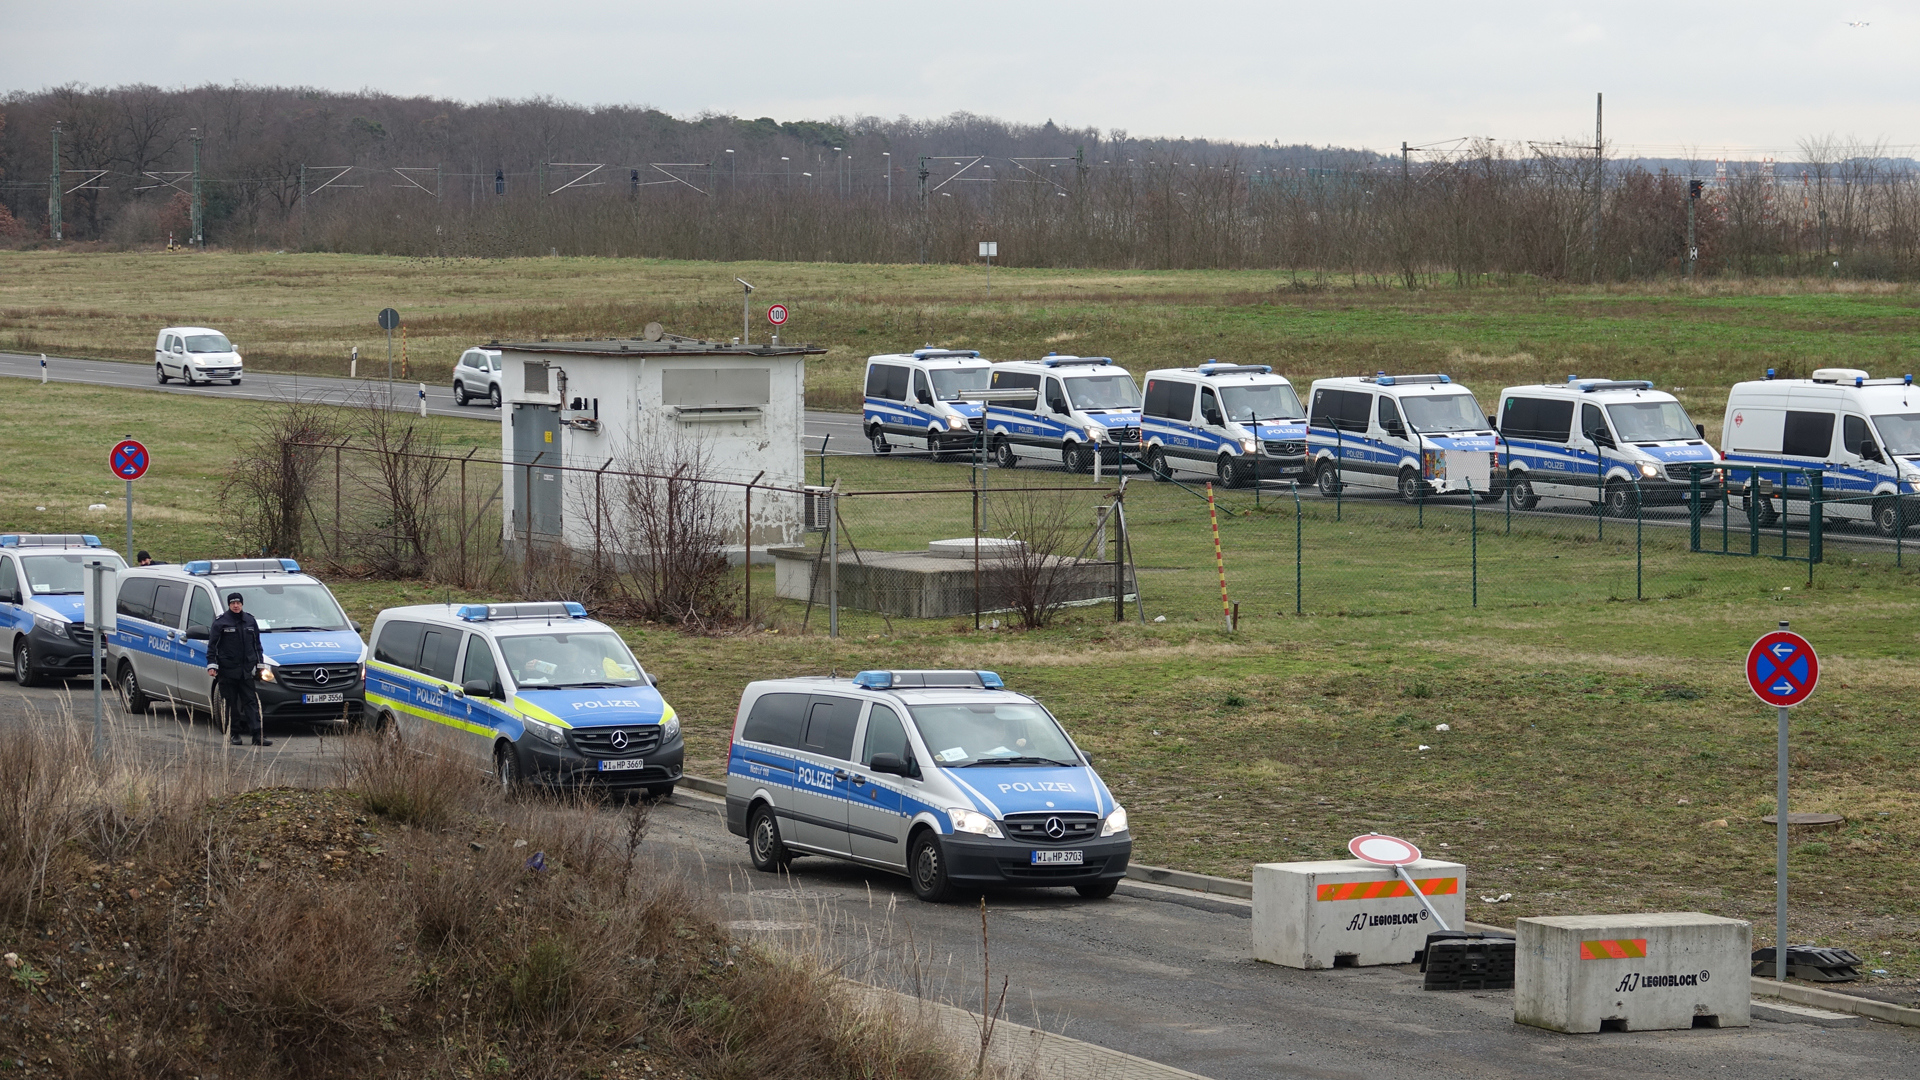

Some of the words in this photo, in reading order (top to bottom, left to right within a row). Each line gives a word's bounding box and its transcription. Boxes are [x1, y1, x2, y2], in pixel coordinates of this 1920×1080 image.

[772, 310, 784, 320] 100
[1018, 425, 1034, 434] POLIZEI
[1173, 436, 1189, 446] POLIZEI
[1452, 440, 1491, 448] POLIZEI
[1346, 450, 1365, 459] POLIZEI
[1665, 450, 1703, 458] POLIZEI
[1544, 460, 1565, 470] POLIZEI
[148, 635, 171, 653] POLIZEI
[278, 641, 341, 650] POLIZEI
[416, 686, 443, 708] POLIZEI
[571, 700, 641, 711] POLIZEI
[602, 761, 611, 770] WI
[616, 761, 626, 769] HP
[627, 760, 643, 769] 3669
[797, 766, 834, 791] POLIZEI
[997, 781, 1077, 794] POLIZEI
[1037, 852, 1047, 862] WI
[1052, 852, 1062, 861] HP
[1064, 851, 1082, 861] 3703
[1345, 912, 1368, 931] AJ
[1615, 972, 1640, 993] AJ
